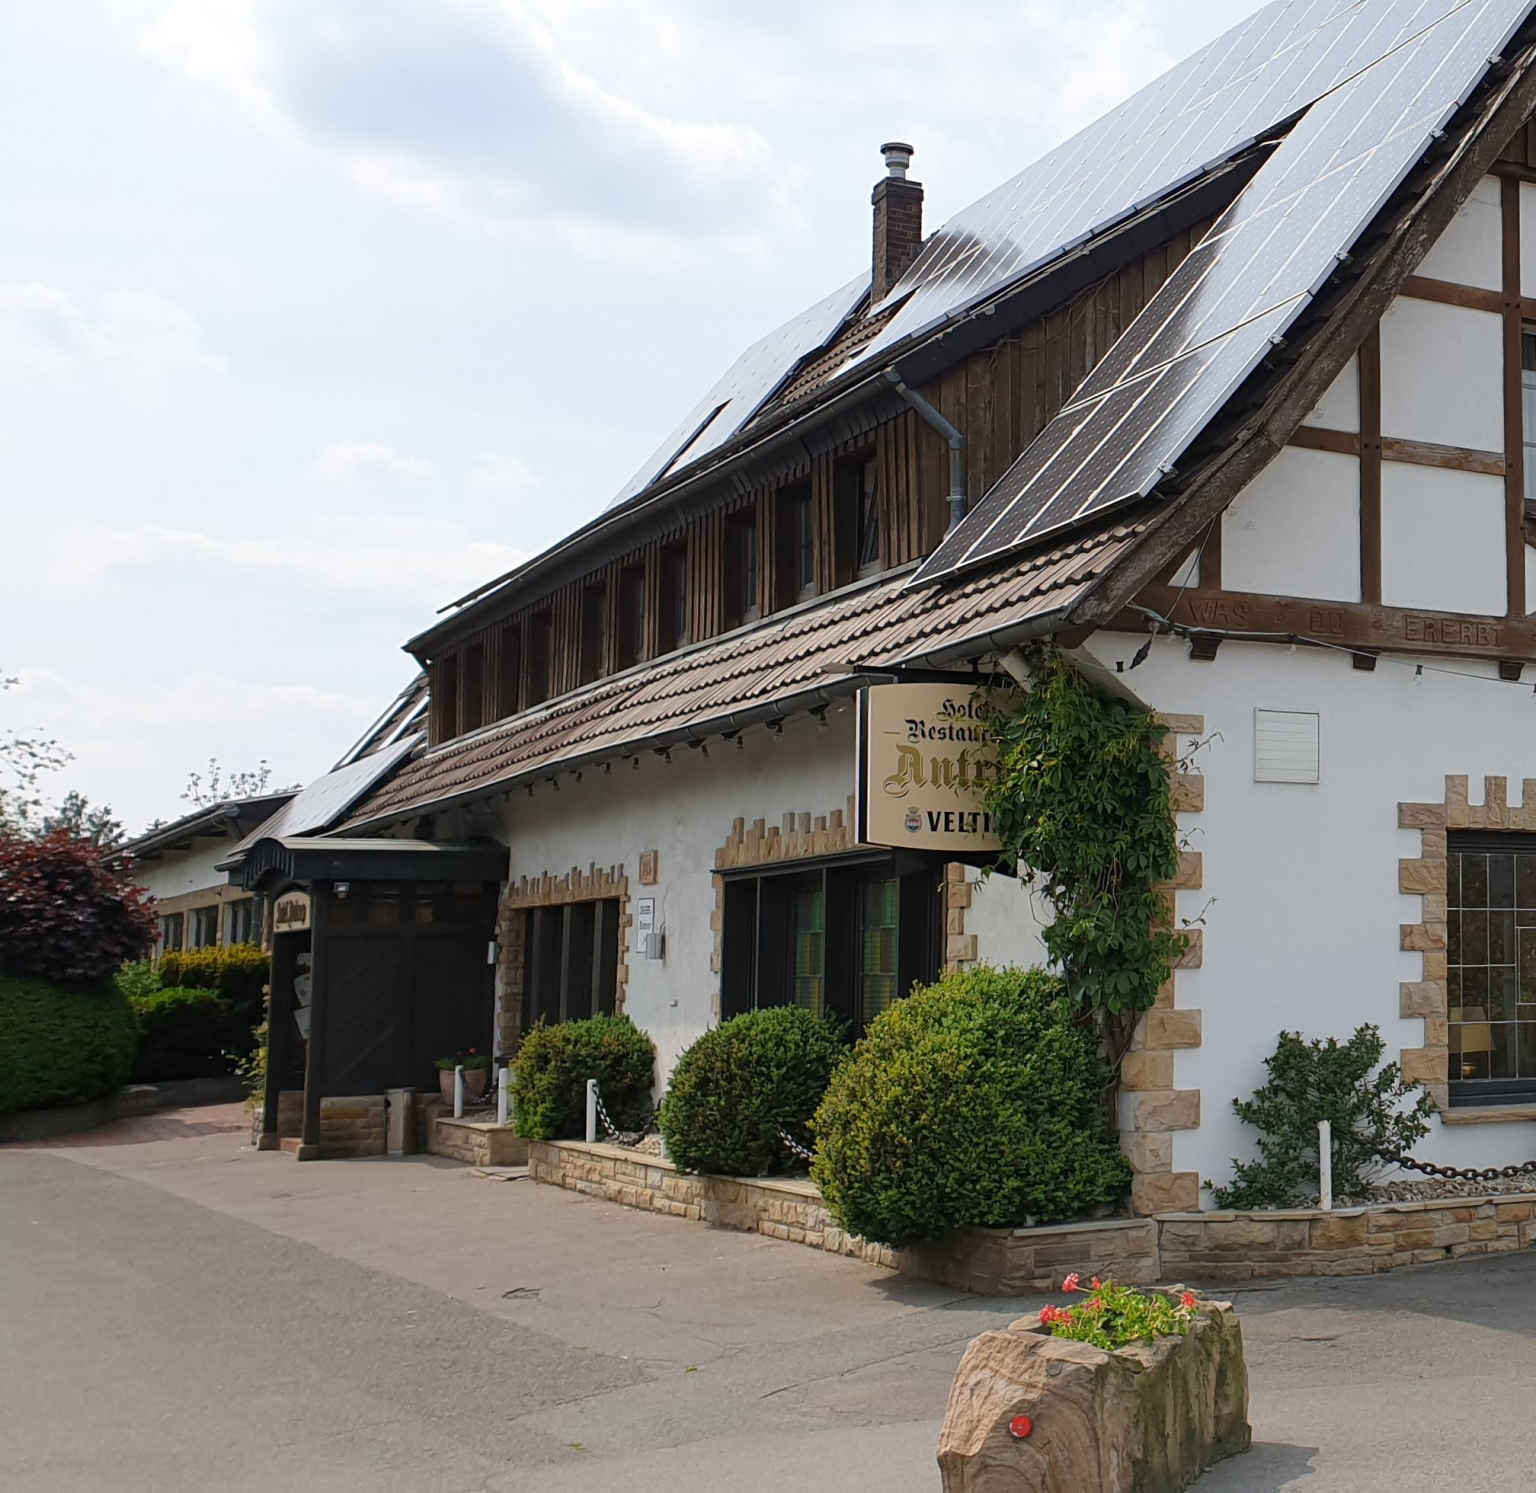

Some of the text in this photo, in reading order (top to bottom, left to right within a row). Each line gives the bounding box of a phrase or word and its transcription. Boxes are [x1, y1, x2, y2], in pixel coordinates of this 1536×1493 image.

[1188, 600, 1248, 627] WAS
[937, 697, 988, 723] Hote
[926, 810, 991, 833] VELTI
